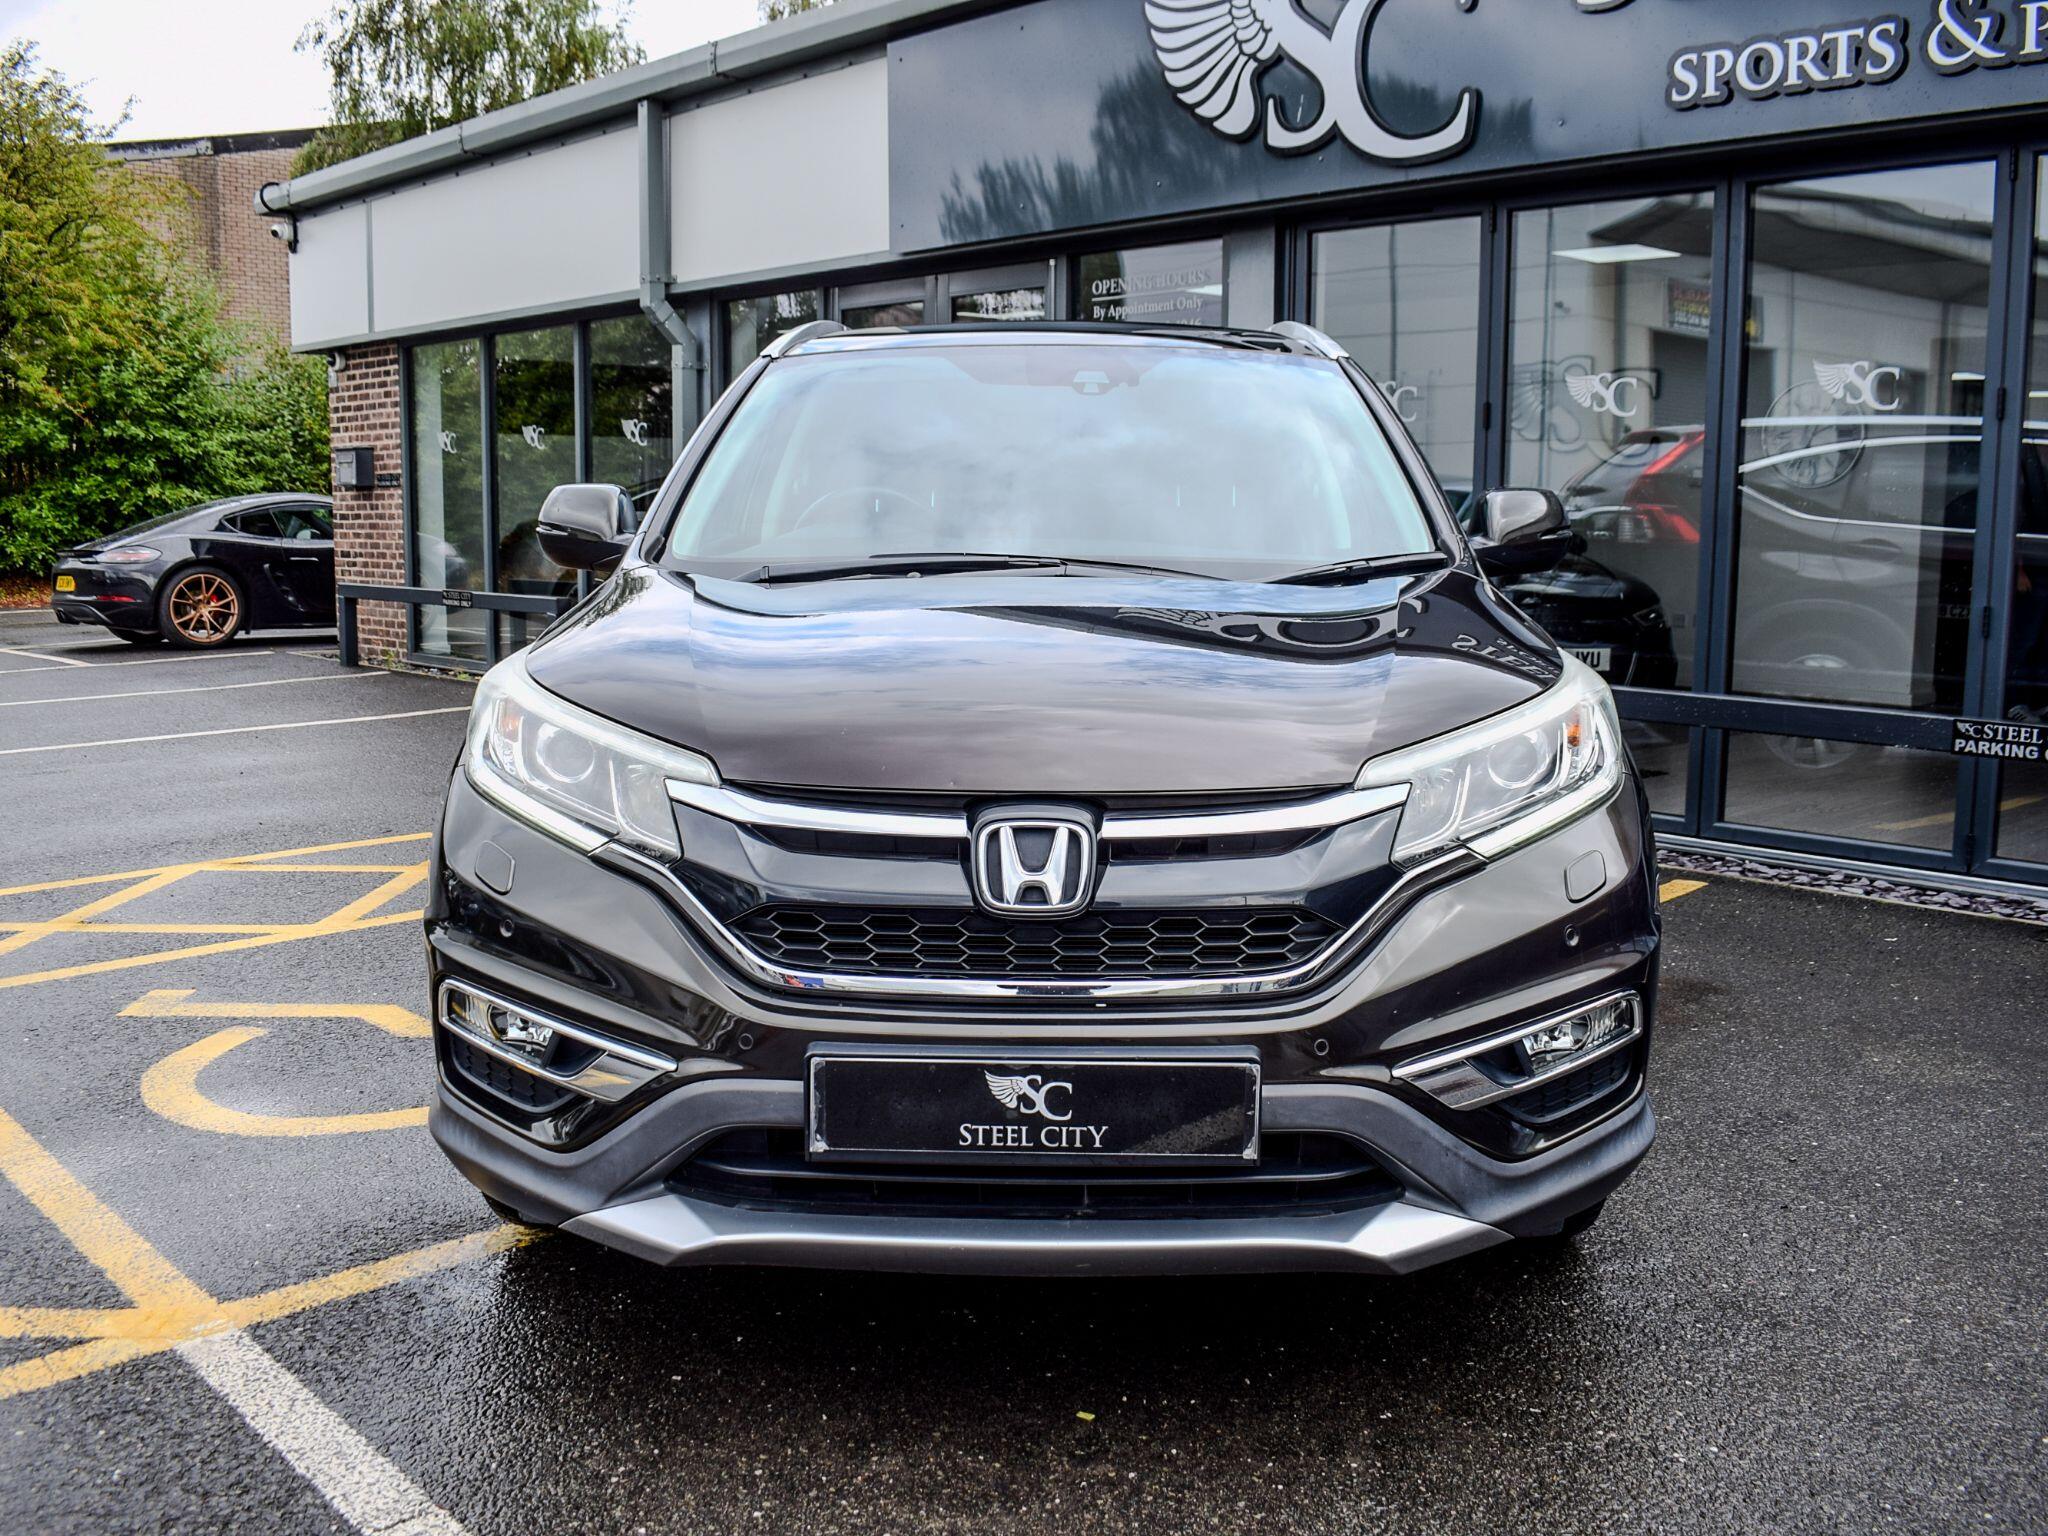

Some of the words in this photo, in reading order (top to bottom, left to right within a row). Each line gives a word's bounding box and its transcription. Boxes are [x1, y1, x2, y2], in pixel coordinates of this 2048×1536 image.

[1670, 21, 1898, 102] SPORTS
[1927, 0, 2007, 65] &
[1092, 275, 1152, 296] OPENING
[1154, 270, 1206, 288] HOURS
[1093, 305, 1106, 320] By
[1107, 300, 1174, 320] Appointment
[1177, 296, 1204, 311] Only
[1593, 372, 1638, 417] SC
[1846, 360, 1901, 411] SC
[1983, 724, 2043, 744] STEEL
[1954, 738, 2039, 759] PARKING
[1020, 1074, 1073, 1120] SC
[958, 1123, 1034, 1146] STEEL
[1040, 1125, 1109, 1148] CITY
